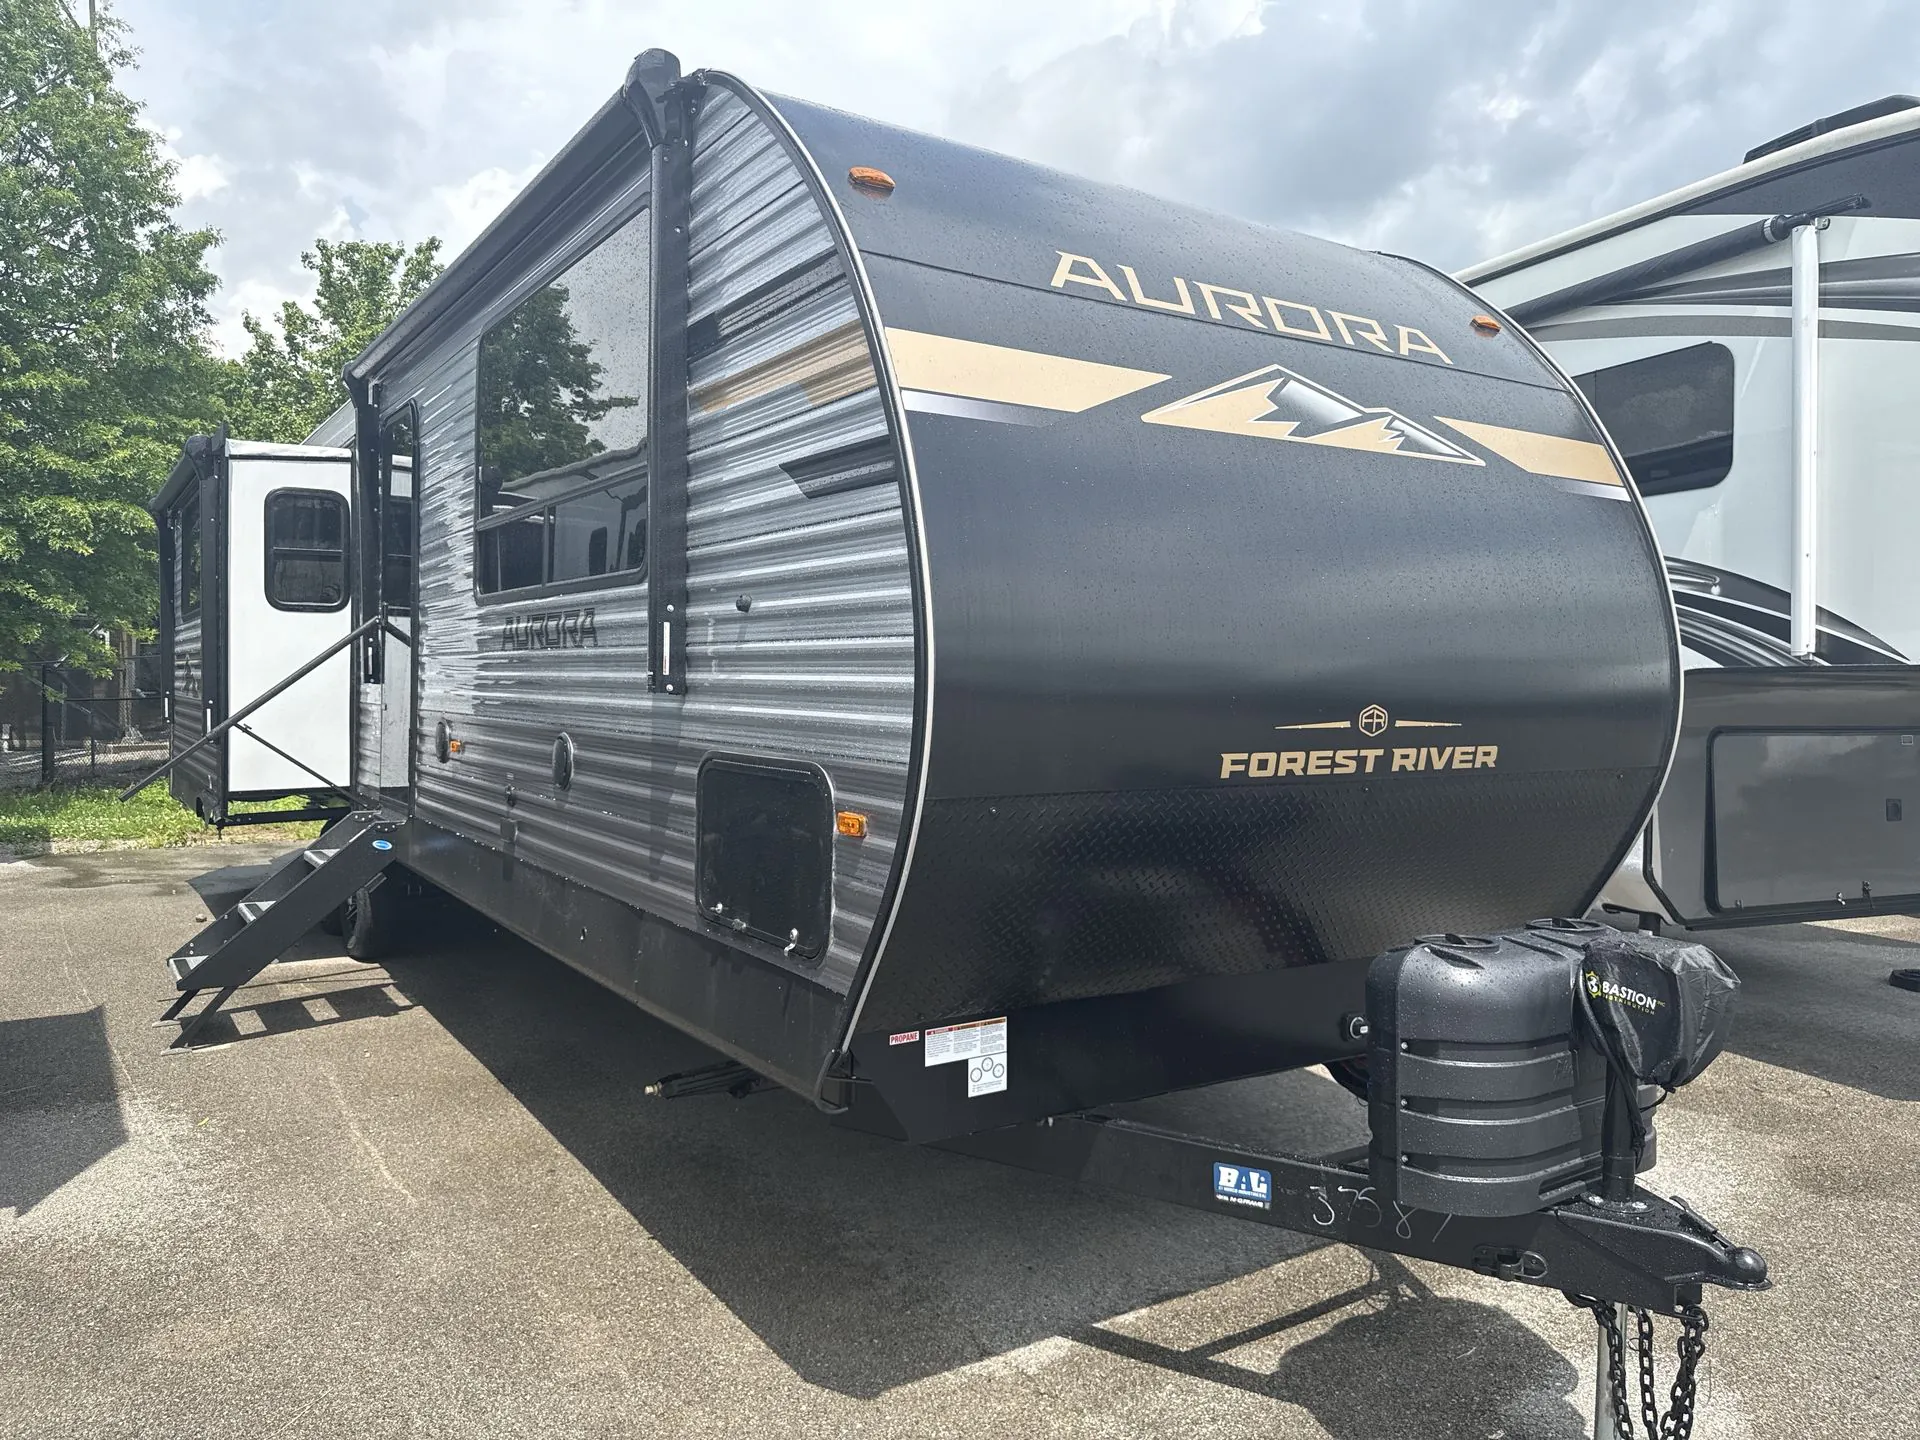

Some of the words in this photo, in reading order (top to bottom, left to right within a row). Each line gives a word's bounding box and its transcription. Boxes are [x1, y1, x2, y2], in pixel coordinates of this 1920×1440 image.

[1050, 250, 1454, 365] AURORA
[501, 608, 598, 650] AURORA
[1220, 748, 1385, 779] FOREST
[1391, 745, 1498, 772] RIVER
[1602, 981, 1657, 1010] BASTION
[890, 1033, 918, 1044] PROPANE
